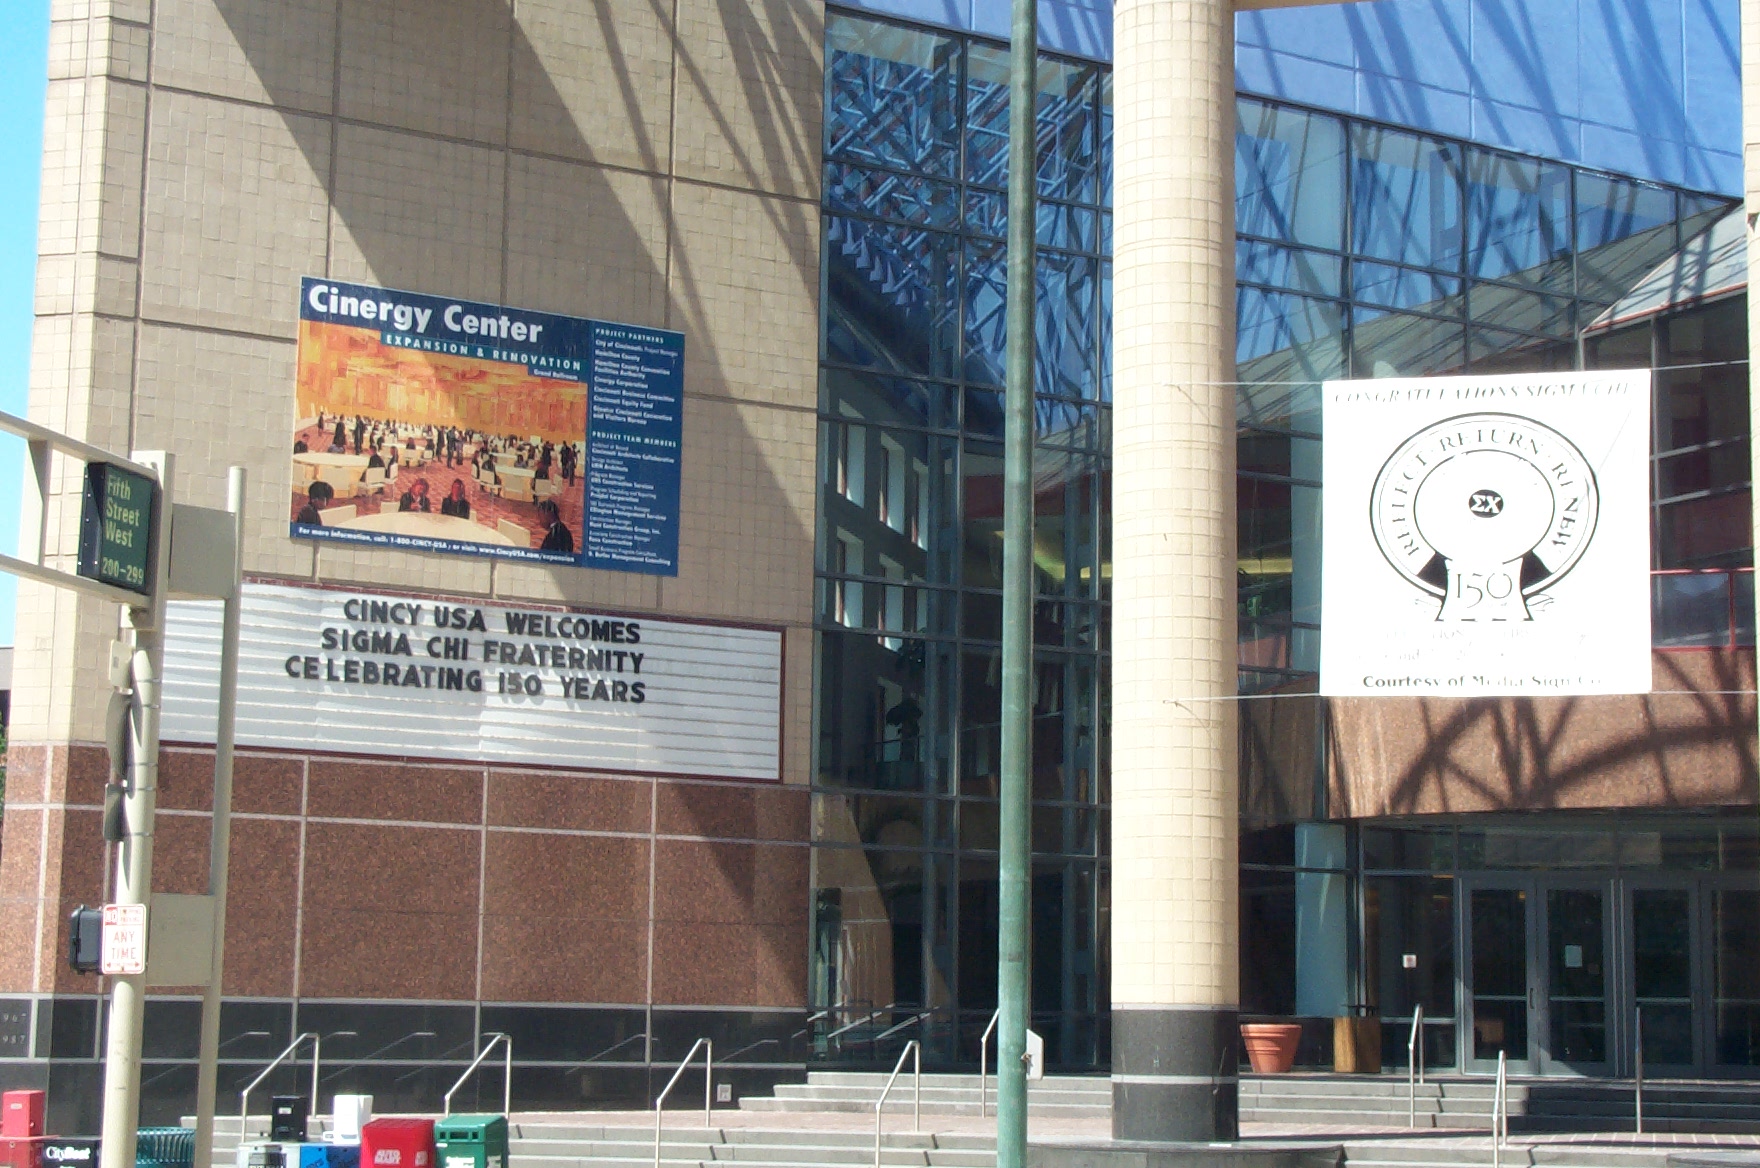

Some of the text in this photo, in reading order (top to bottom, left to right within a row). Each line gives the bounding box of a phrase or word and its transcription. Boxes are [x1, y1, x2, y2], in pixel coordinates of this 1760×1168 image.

[309, 284, 543, 343] Cinergy Center
[386, 334, 581, 372] EXPANSION & RENOVATION
[107, 474, 131, 500] Fifth
[106, 497, 140, 527] Street
[105, 520, 133, 548] West
[102, 557, 144, 585] 200-299
[1456, 573, 1512, 608] 150
[344, 599, 641, 645] CINCY USA WELCOMES
[321, 627, 644, 674] SIGMA CHI FRATERNITY
[285, 655, 646, 703] CELEBRATING 150 YEARS
[1362, 675, 1441, 688] Courtesy
[1447, 675, 1465, 687] of
[113, 931, 135, 943] ANY
[112, 947, 136, 960] TIME
